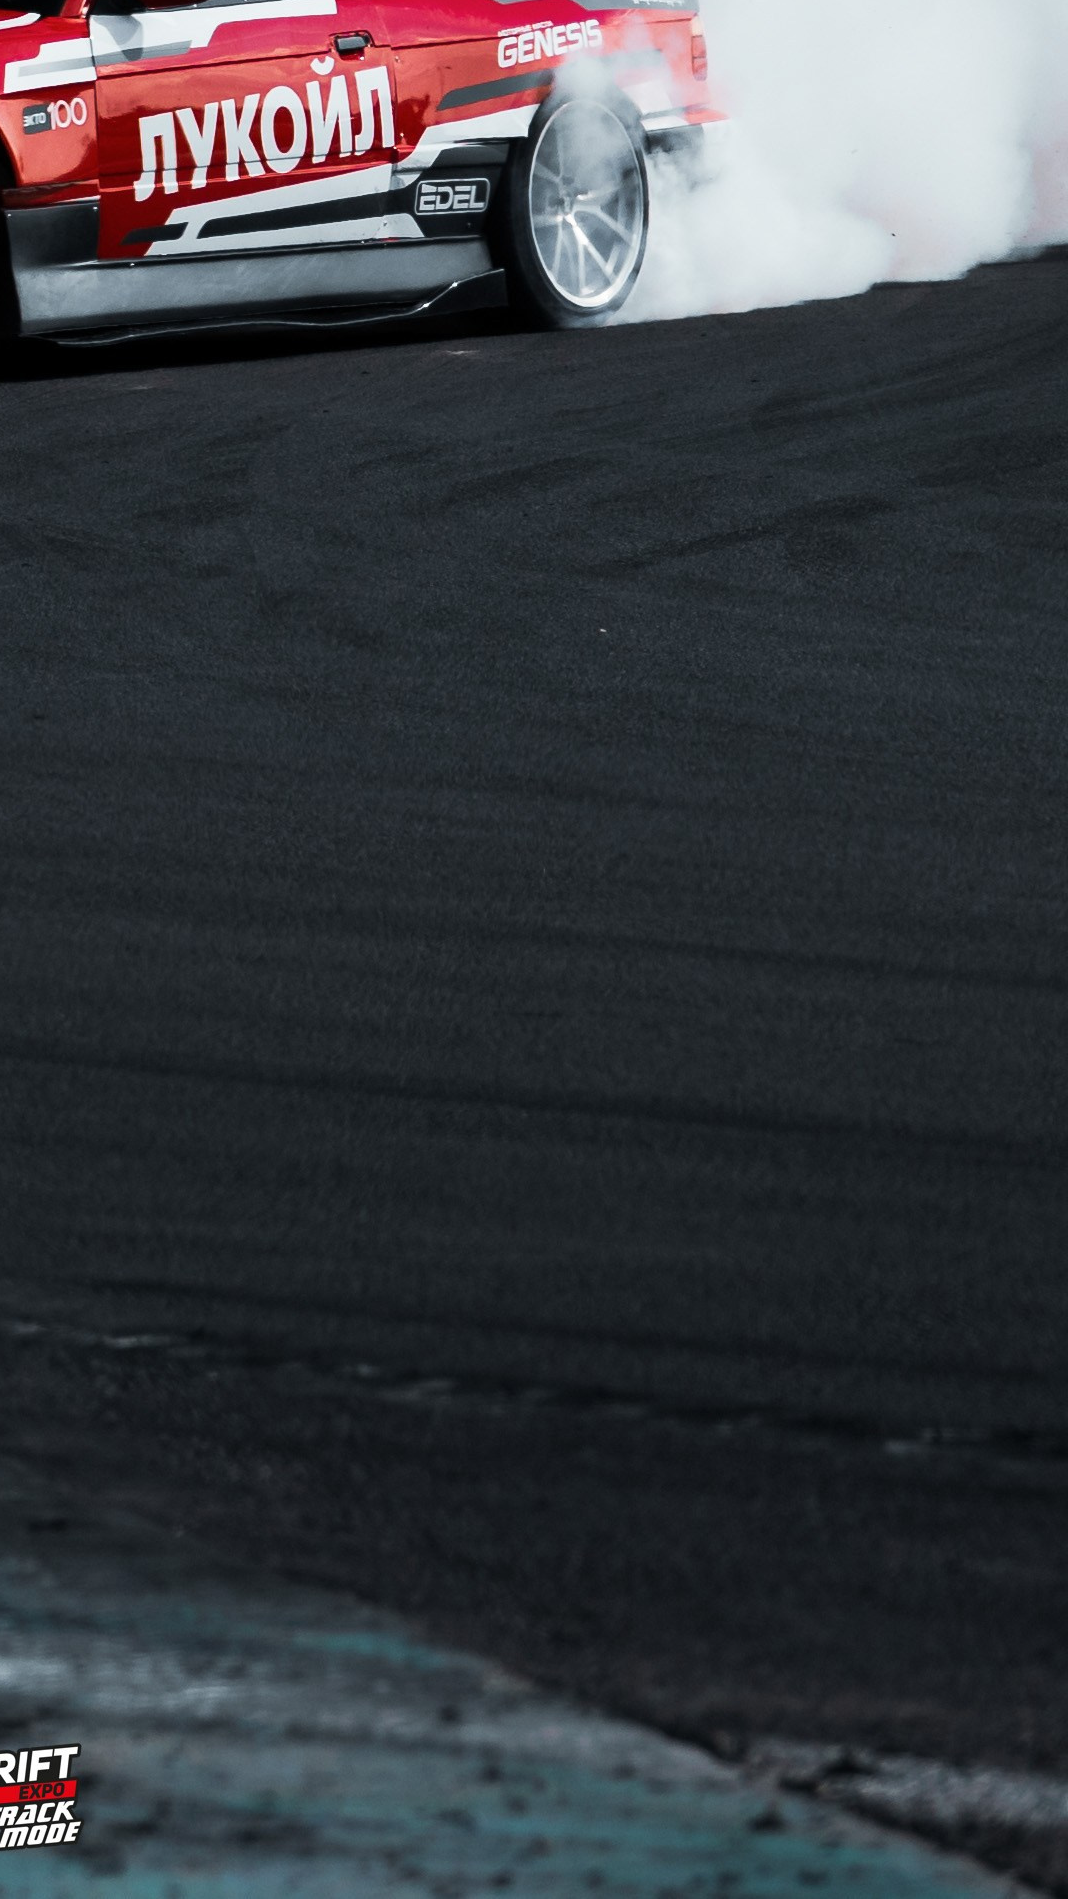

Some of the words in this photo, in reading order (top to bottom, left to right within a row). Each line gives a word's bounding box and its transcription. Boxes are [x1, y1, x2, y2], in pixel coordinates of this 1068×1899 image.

[498, 19, 603, 68] GENESIS
[47, 97, 88, 130] 100
[134, 56, 395, 202] ЛУКОЙЛ
[419, 184, 485, 210] EDEL
